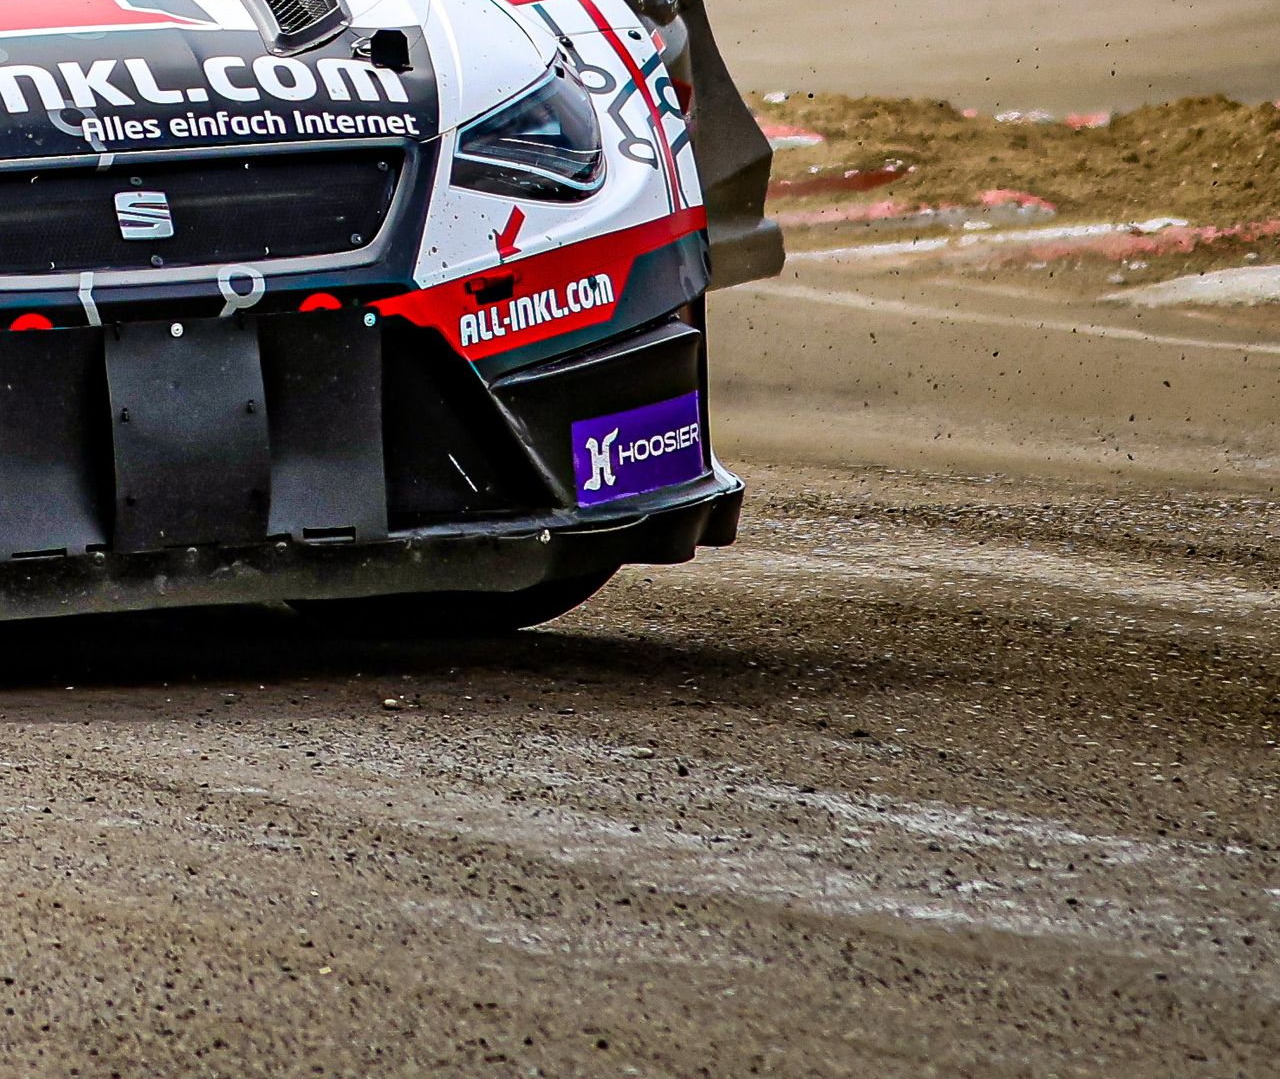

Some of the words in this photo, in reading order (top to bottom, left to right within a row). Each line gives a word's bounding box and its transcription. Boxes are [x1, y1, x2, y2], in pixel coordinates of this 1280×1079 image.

[82, 114, 162, 142] Alles
[168, 112, 287, 139] einfach
[295, 109, 419, 138] Internet
[618, 423, 699, 465] HOOSIER
